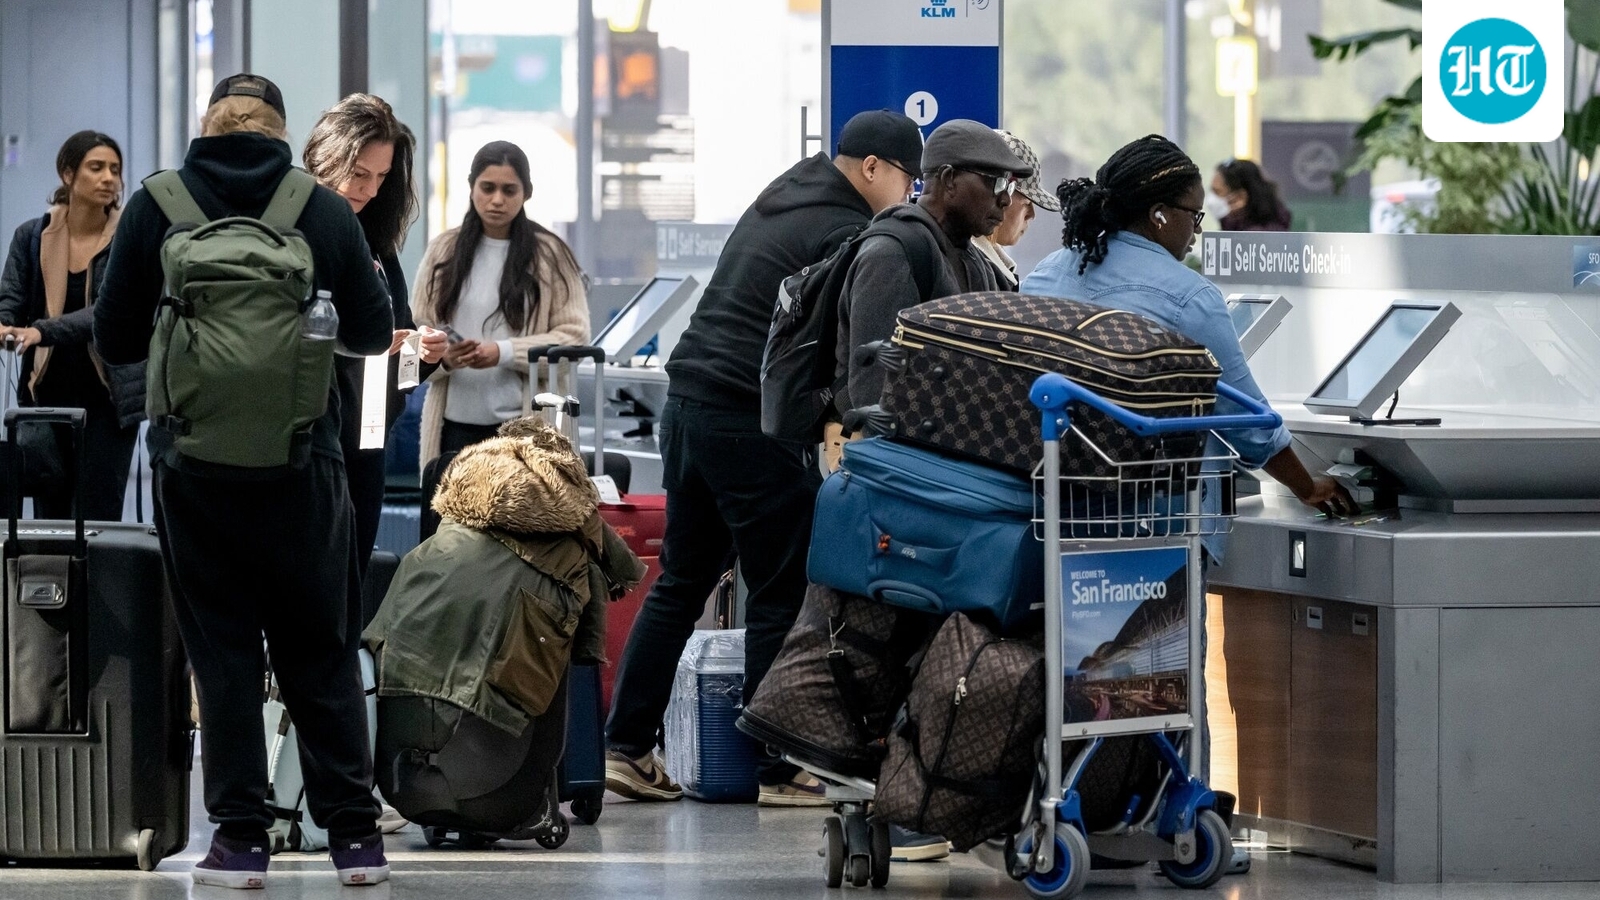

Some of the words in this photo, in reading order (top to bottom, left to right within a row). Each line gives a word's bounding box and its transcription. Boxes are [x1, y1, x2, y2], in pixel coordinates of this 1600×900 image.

[921, 8, 955, 17] KLM
[916, 99, 925, 118] 1
[1235, 243, 1256, 272] Self
[1259, 243, 1299, 273] Service
[1302, 244, 1350, 275] Check-in
[1588, 253, 1600, 264] SFO
[1070, 571, 1097, 580] WELCOME
[1098, 569, 1106, 578] TO
[1072, 581, 1099, 605] San
[1101, 576, 1167, 603] Francisco
